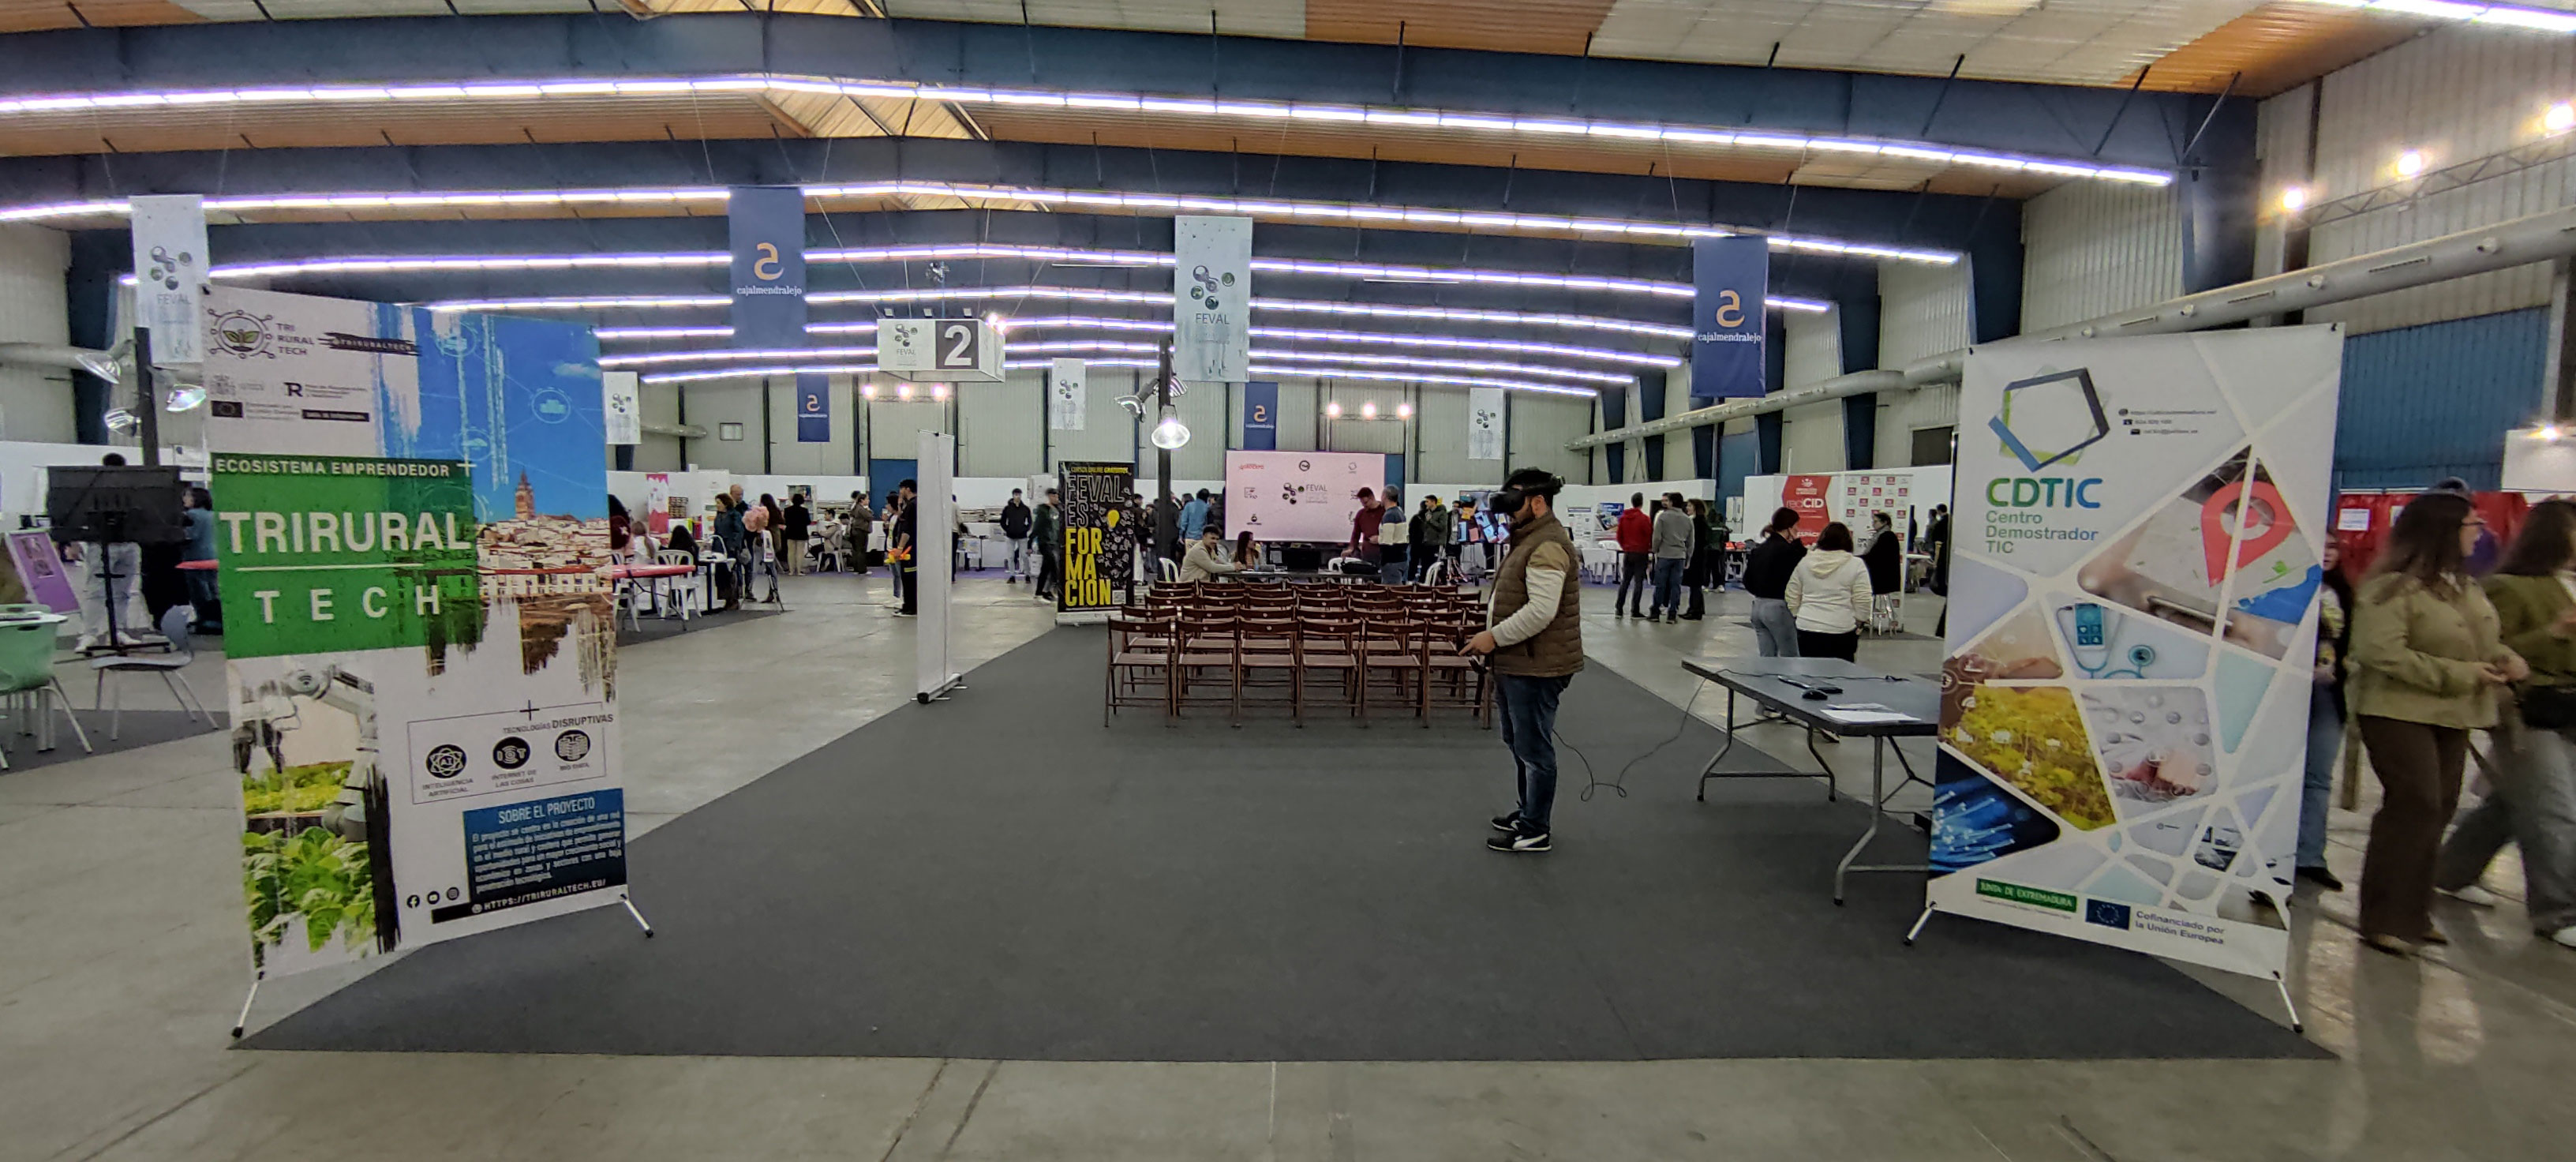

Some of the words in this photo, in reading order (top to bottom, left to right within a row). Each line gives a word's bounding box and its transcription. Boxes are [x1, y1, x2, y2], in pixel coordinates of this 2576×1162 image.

[156, 293, 192, 305] FEVAL
[736, 285, 803, 297] cajalmendralejo
[276, 323, 296, 332] TRI
[1195, 313, 1230, 324] FEVAL
[278, 335, 315, 345] RURAL
[944, 324, 972, 366] 2
[1698, 332, 1762, 344] cajalmendralejo
[278, 346, 308, 355] TECH
[215, 459, 326, 474] ECOSISTEMA
[331, 461, 450, 477] EMPRENDEDOR
[1066, 474, 1125, 503] FEVAL
[1986, 478, 2103, 508] CDTIC
[1066, 500, 1089, 528] ES
[1986, 510, 2043, 524] Centro
[219, 512, 472, 553] TRIRURAL
[1065, 527, 1103, 555] FOR
[1986, 525, 2099, 541] Demostrador
[1986, 541, 2014, 553] TIC
[1065, 553, 1097, 580] MA
[1065, 579, 1111, 606] CION
[253, 585, 440, 624] TECH
[552, 714, 614, 729] DISRUPTIVAS
[498, 806, 532, 824] SOBRE
[534, 804, 546, 819] EL
[547, 797, 595, 816] PROYECTO
[2005, 886, 2014, 897] DE
[2136, 910, 2204, 930] Cofinanciado
[2207, 925, 2225, 935] por
[2136, 920, 2144, 929] la
[2147, 923, 2177, 935] Unión
[2180, 929, 2224, 945] Europea
